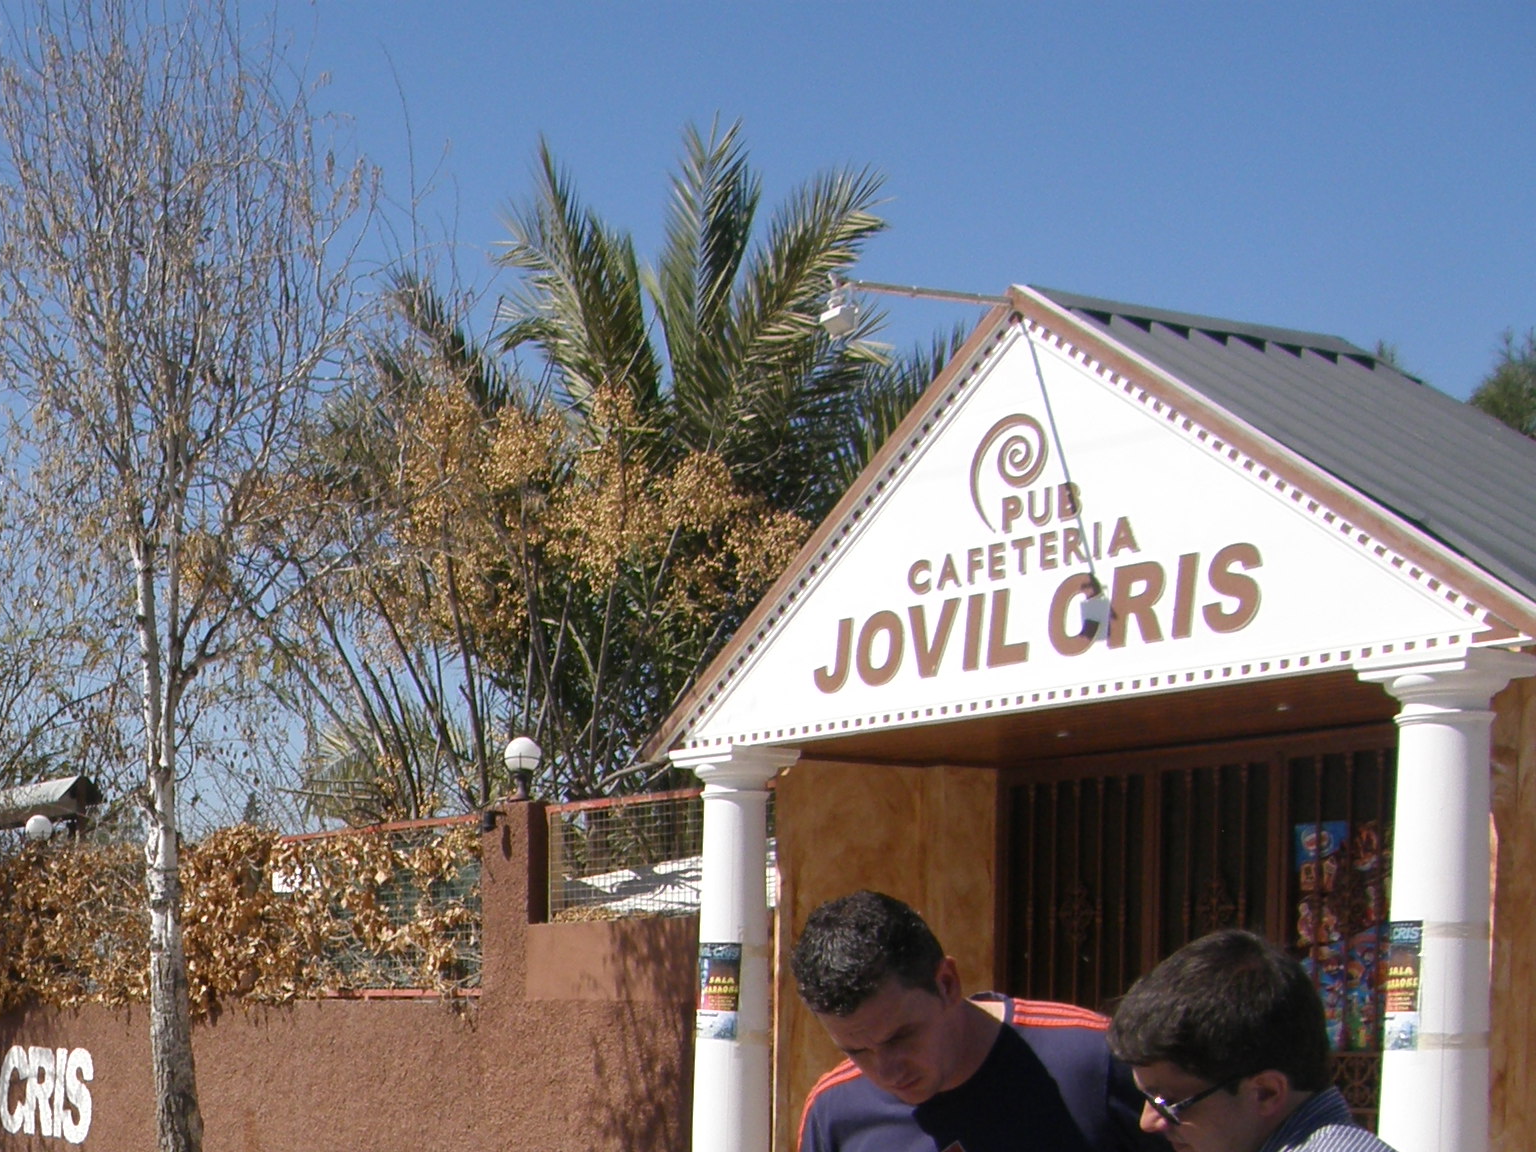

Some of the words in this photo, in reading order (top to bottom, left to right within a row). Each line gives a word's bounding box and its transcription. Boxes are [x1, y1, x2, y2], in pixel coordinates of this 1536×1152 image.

[1000, 481, 1084, 534] PUB
[906, 515, 1142, 596] CAFETERIA
[813, 587, 1031, 695] JOVIL
[1047, 541, 1264, 658] CRIS
